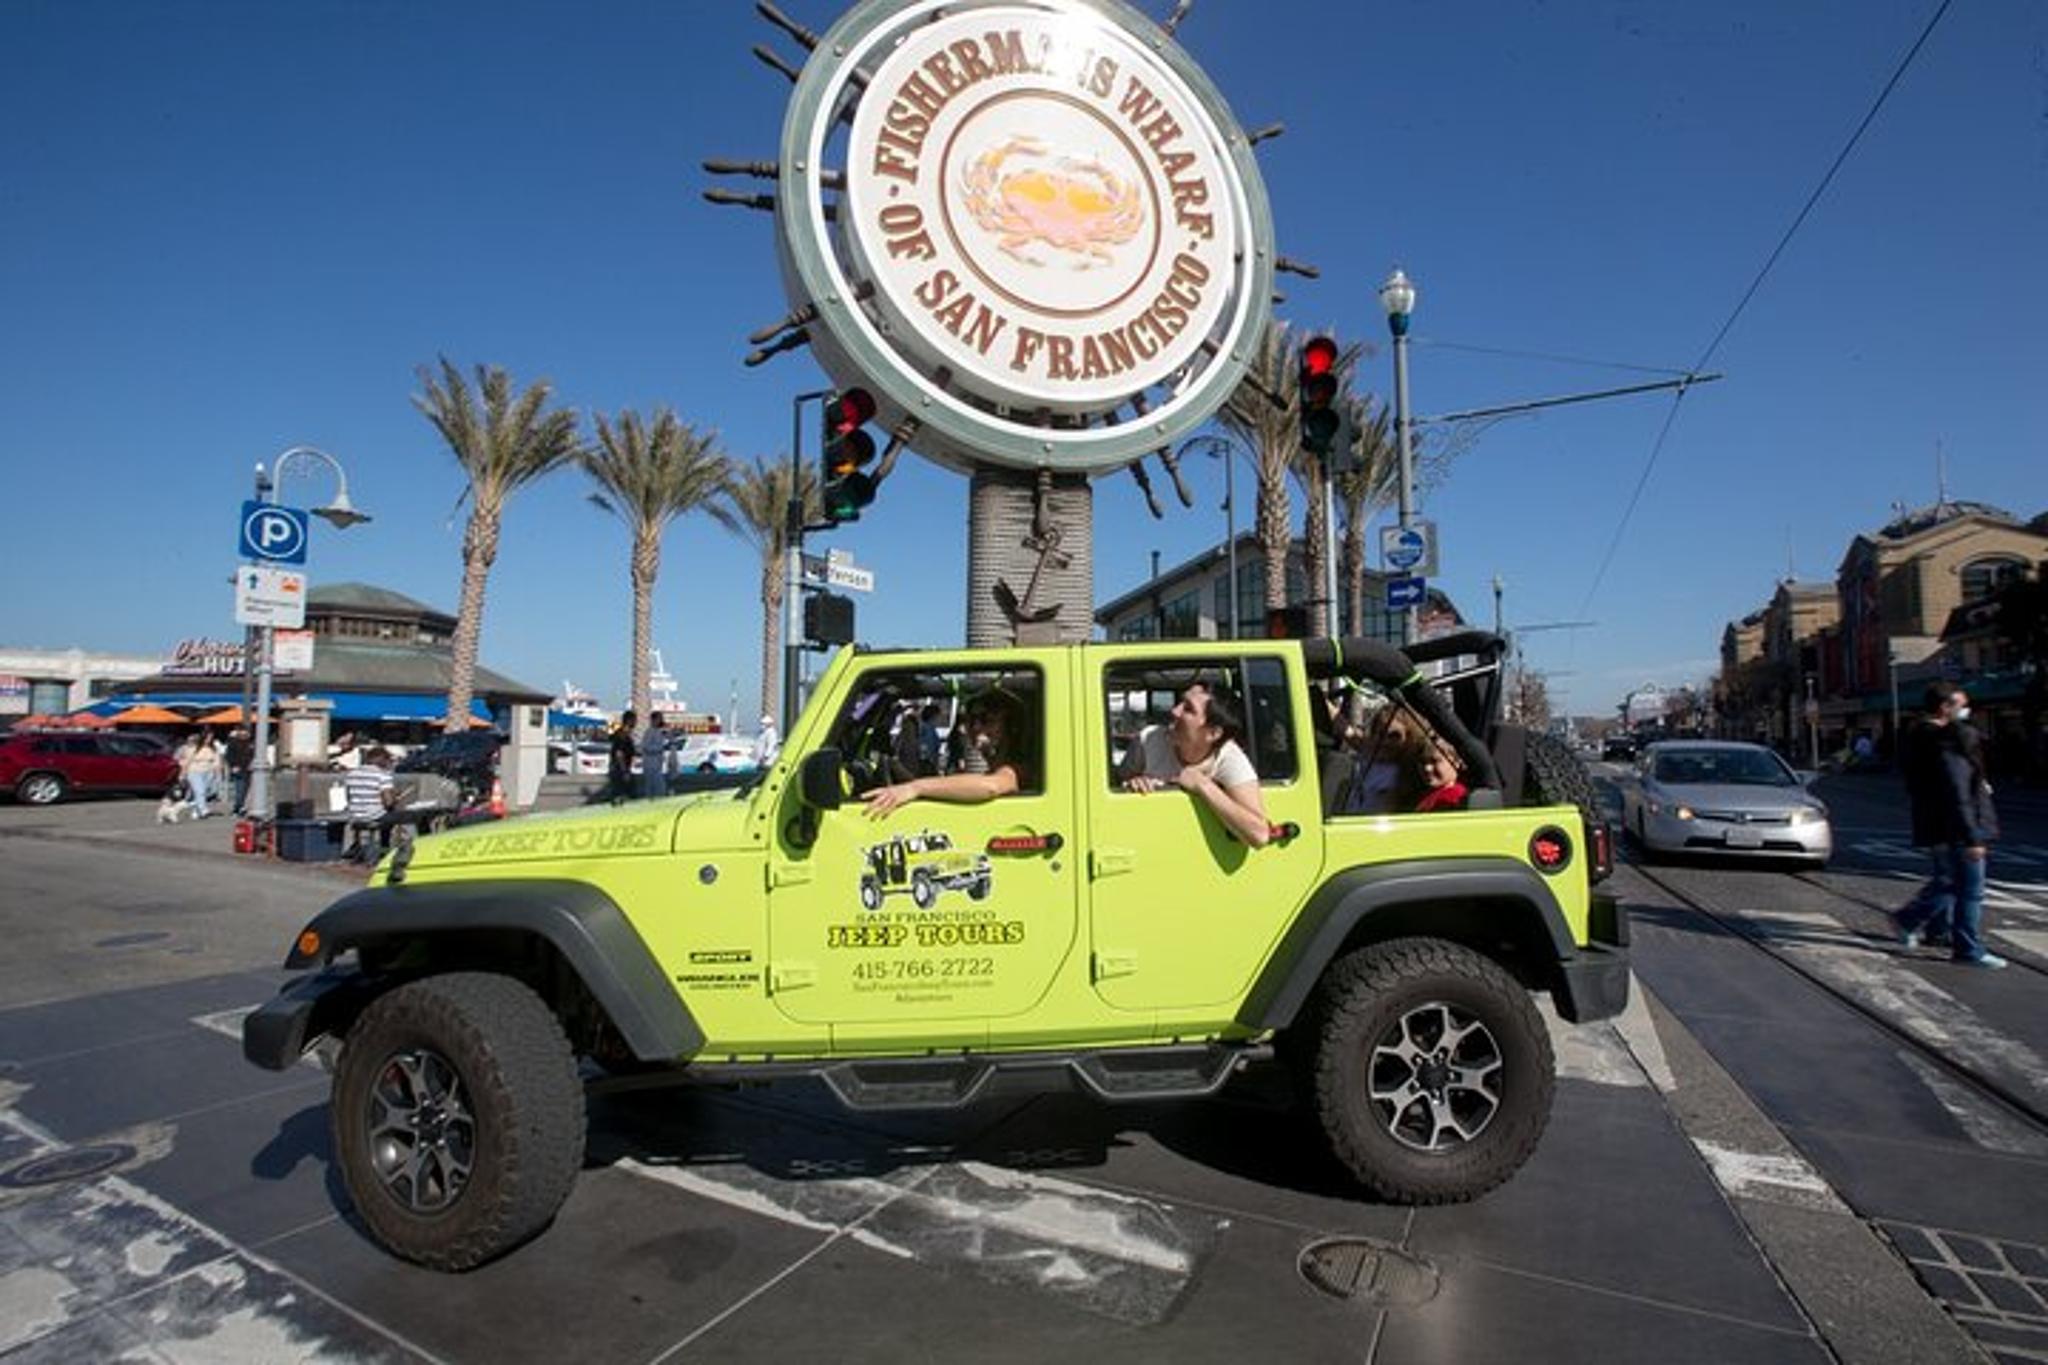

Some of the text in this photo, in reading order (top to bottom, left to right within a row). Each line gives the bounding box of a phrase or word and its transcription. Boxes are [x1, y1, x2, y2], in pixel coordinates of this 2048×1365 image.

[1117, 75, 1215, 241] WHARF
[878, 203, 1212, 382] OF SAN FRANCISCO
[261, 515, 291, 547] P
[552, 824, 658, 852] TOURS
[855, 910, 997, 923] SAN FRANCISCO
[827, 921, 1025, 948] JEEP TOURS
